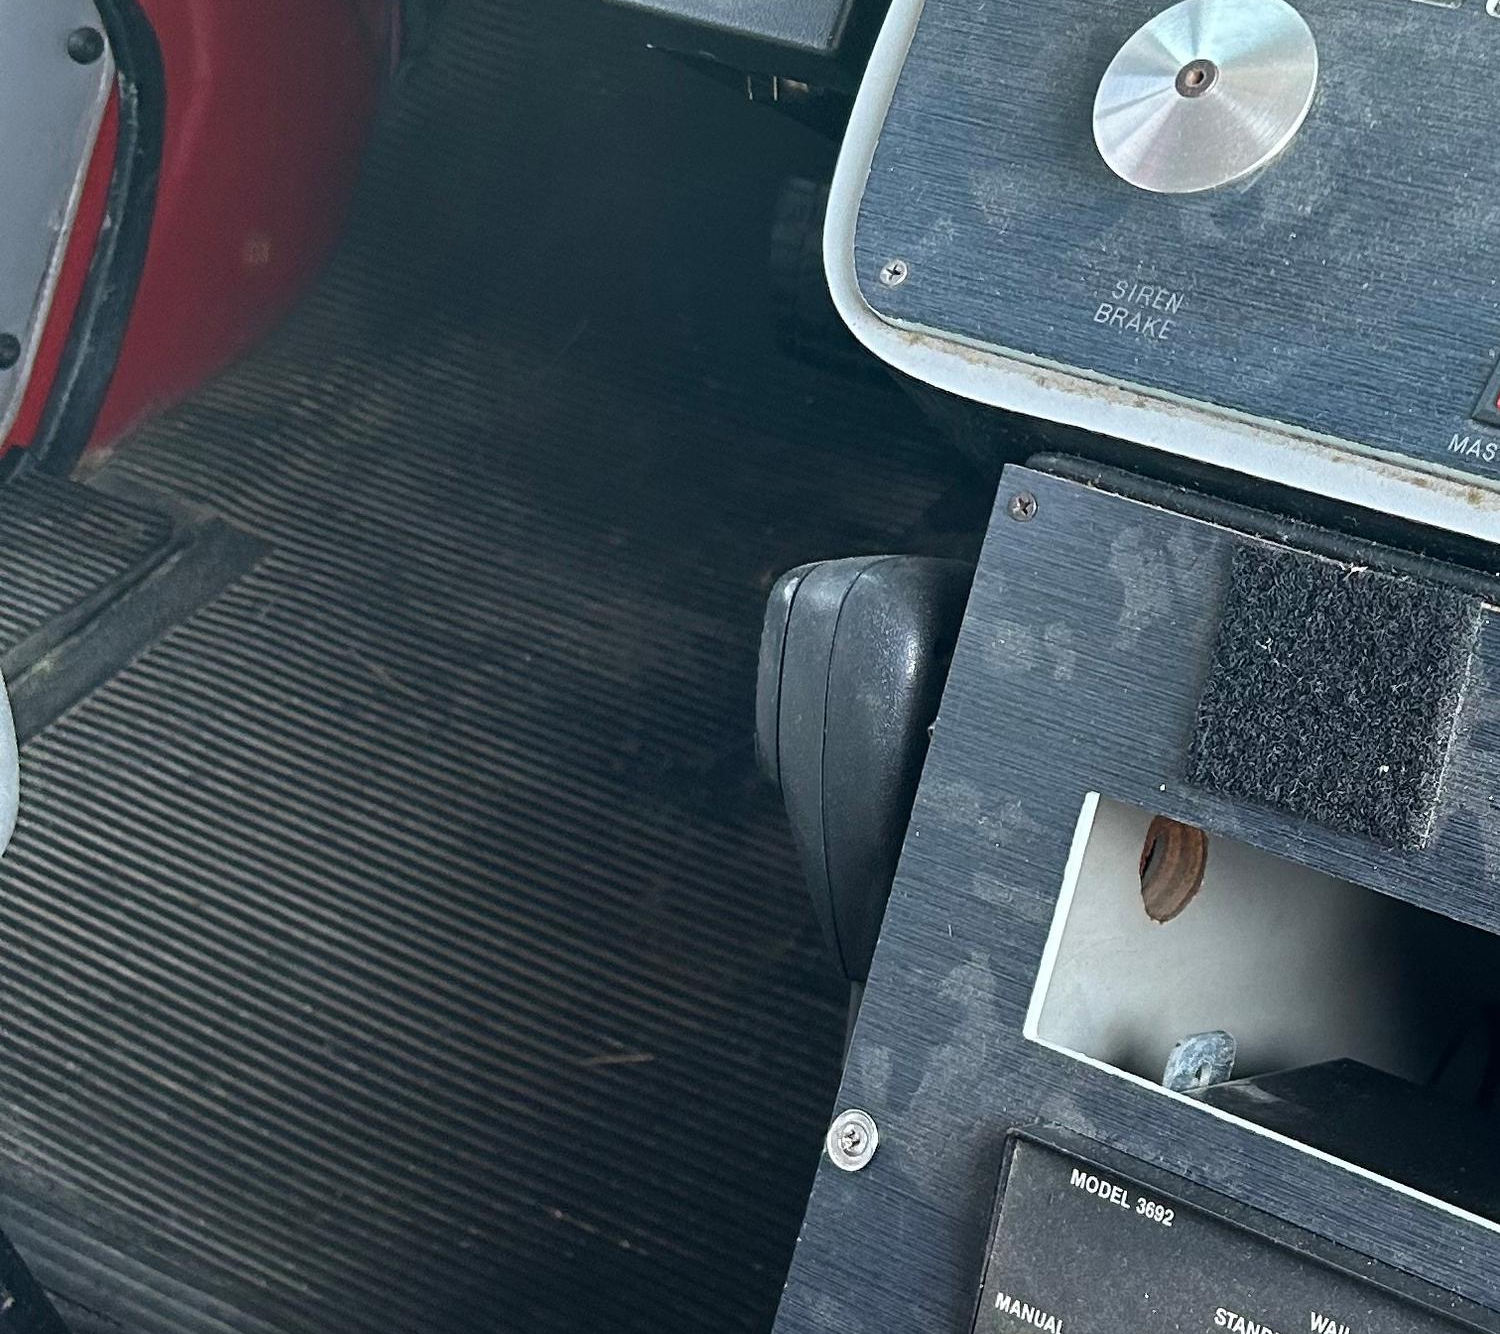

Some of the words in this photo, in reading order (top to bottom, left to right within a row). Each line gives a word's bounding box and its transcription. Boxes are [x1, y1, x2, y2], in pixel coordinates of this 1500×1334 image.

[1112, 280, 1185, 314] SIREN
[1093, 302, 1176, 340] BRAKE
[1069, 1168, 1131, 1209] MODEL
[1135, 1197, 1176, 1227] 3692
